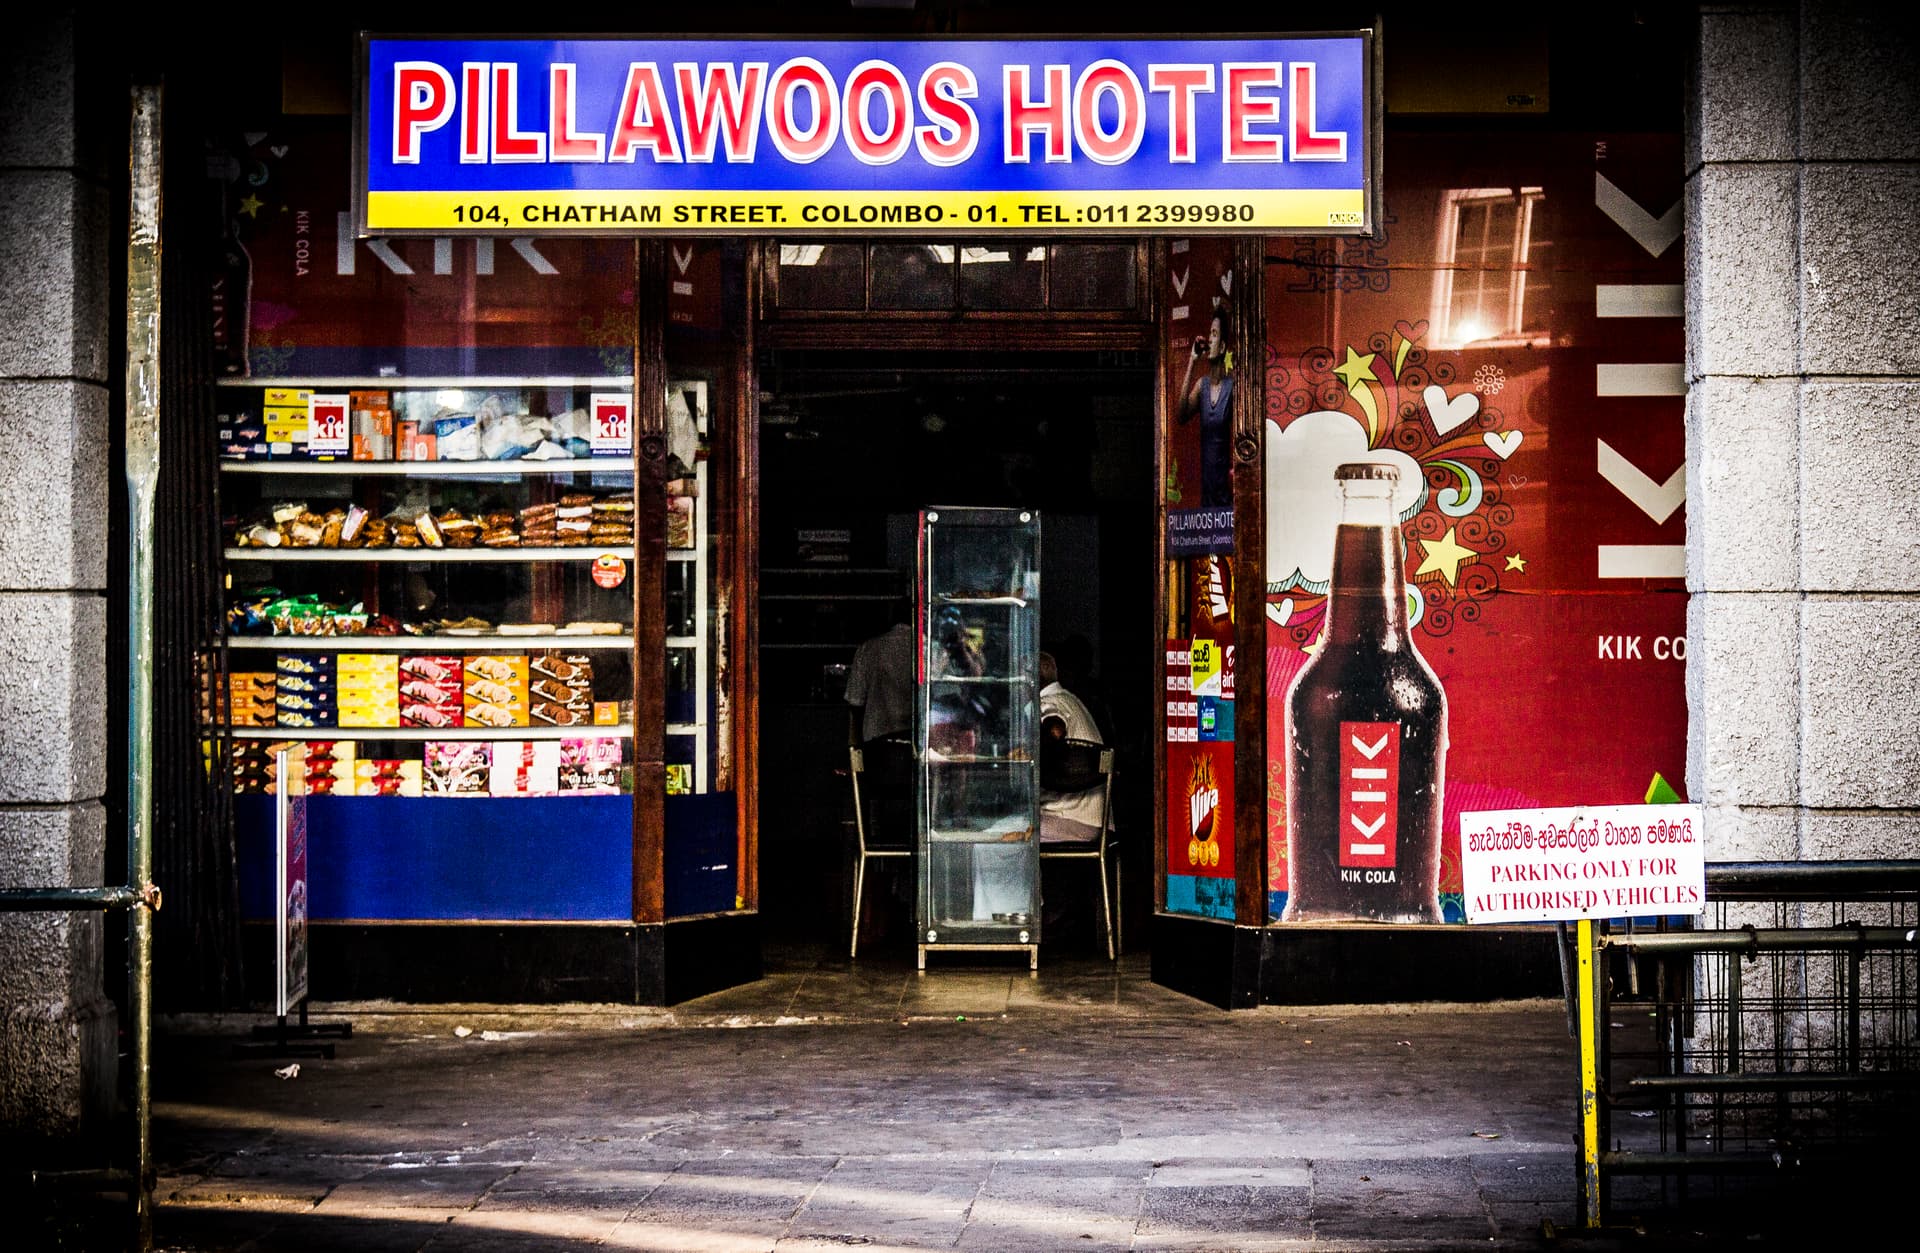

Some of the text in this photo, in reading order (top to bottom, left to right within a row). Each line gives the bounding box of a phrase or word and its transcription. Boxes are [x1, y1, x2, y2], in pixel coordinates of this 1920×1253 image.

[392, 56, 1349, 166] PILLAWOOS HOTEL
[453, 205, 509, 226] 104,
[522, 205, 662, 223] CHATHAM
[673, 205, 787, 223] STREET.
[802, 205, 943, 222] COLOMBO
[968, 205, 1007, 222] 01.
[296, 210, 310, 277] KIK COLA
[313, 415, 344, 438] kit
[596, 414, 627, 438] kit
[1168, 513, 1213, 530] PILLAWOOS
[1599, 635, 1642, 660] KIK
[1351, 733, 1388, 855] KIK
[1190, 786, 1219, 836] Viva
[1604, 821, 1642, 846] වාහන
[1341, 869, 1396, 884] KIK COLA
[1491, 857, 1677, 883] PARKING ONLY FOR
[1473, 885, 1698, 913] AUTHORISED VEHICLES
